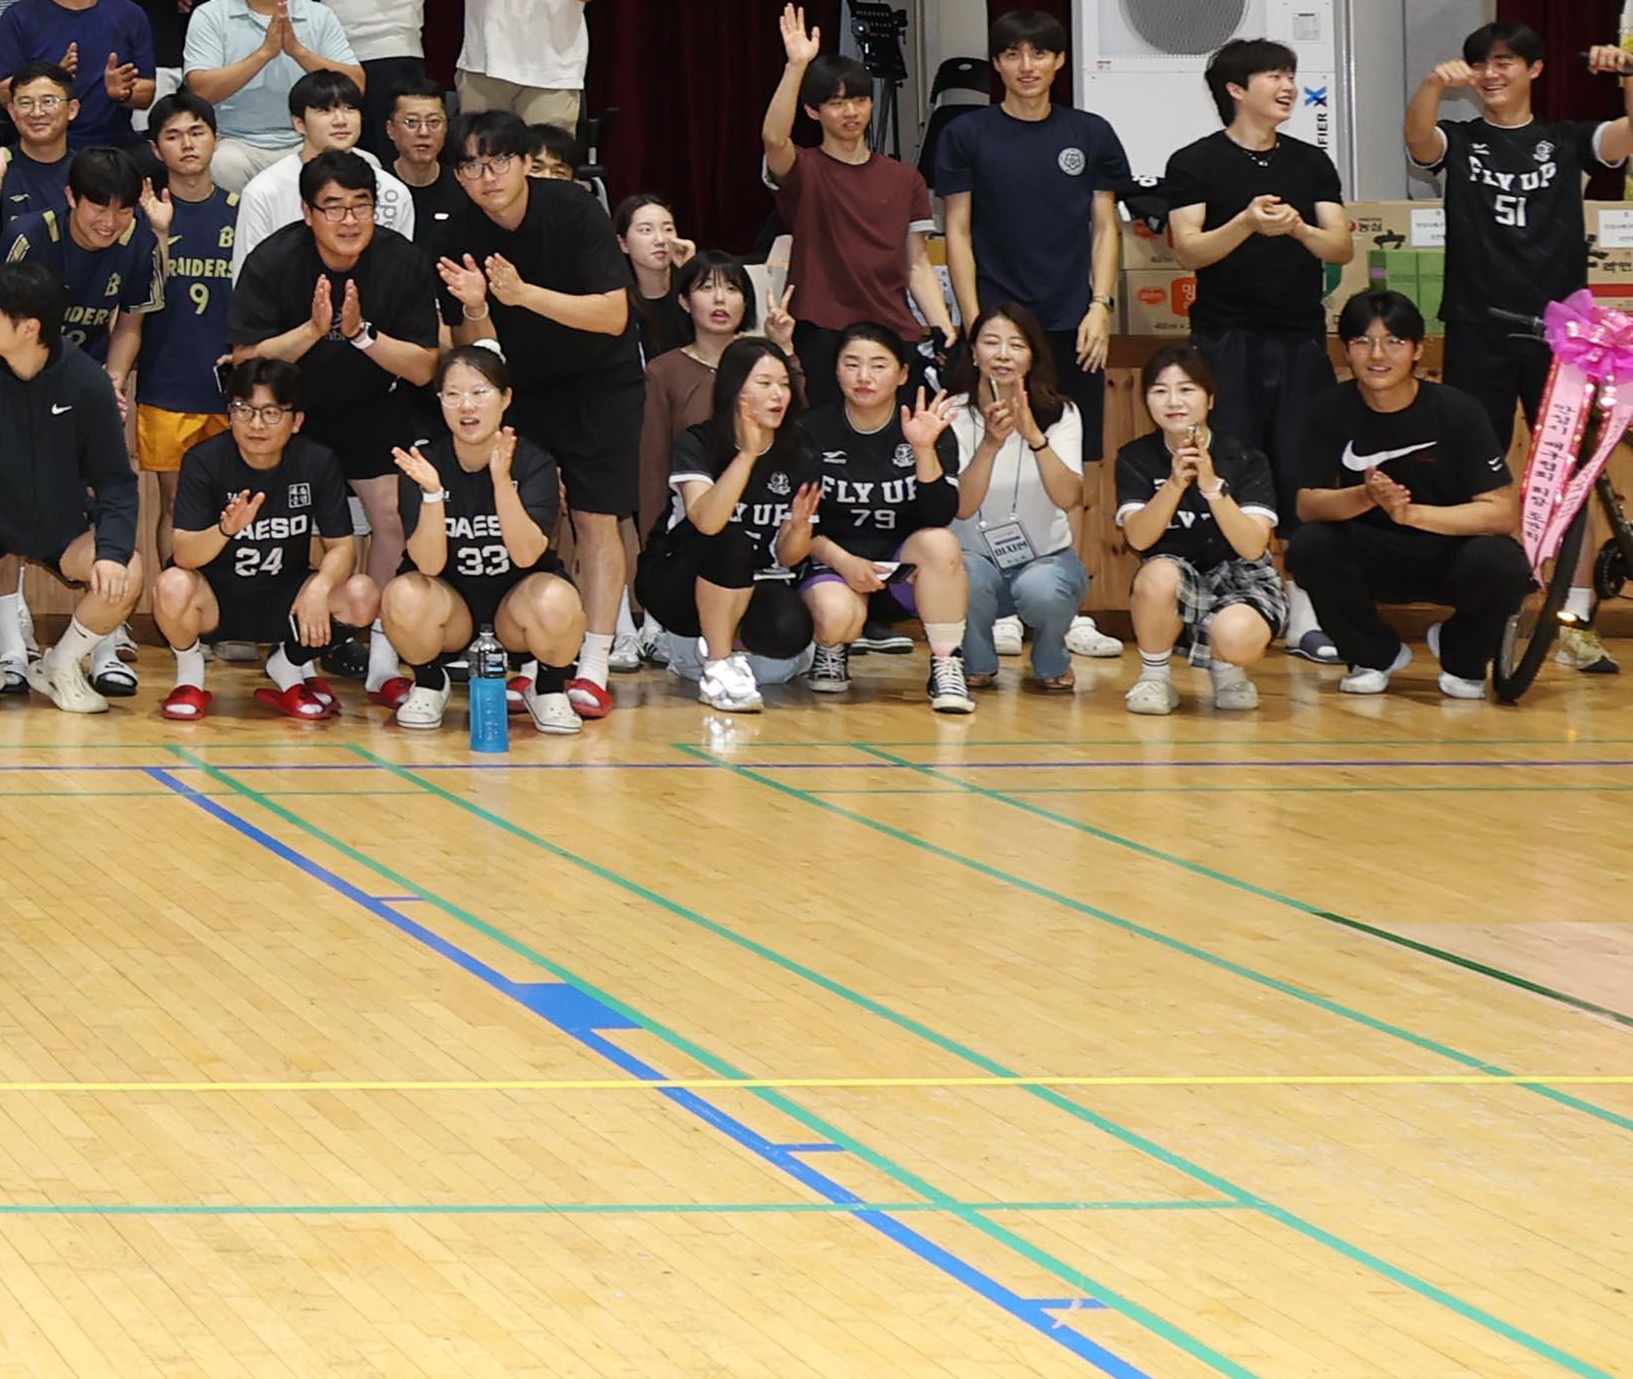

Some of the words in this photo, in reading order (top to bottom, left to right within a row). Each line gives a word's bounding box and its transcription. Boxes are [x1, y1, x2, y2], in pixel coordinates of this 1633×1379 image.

[1469, 156, 1516, 191] FLY
[1520, 163, 1557, 190] UP
[1495, 195, 1527, 227] 51
[189, 281, 210, 315] 9
[821, 474, 875, 504] FLY
[850, 508, 897, 529] 79
[234, 546, 284, 577] 24
[457, 544, 511, 577] 33
